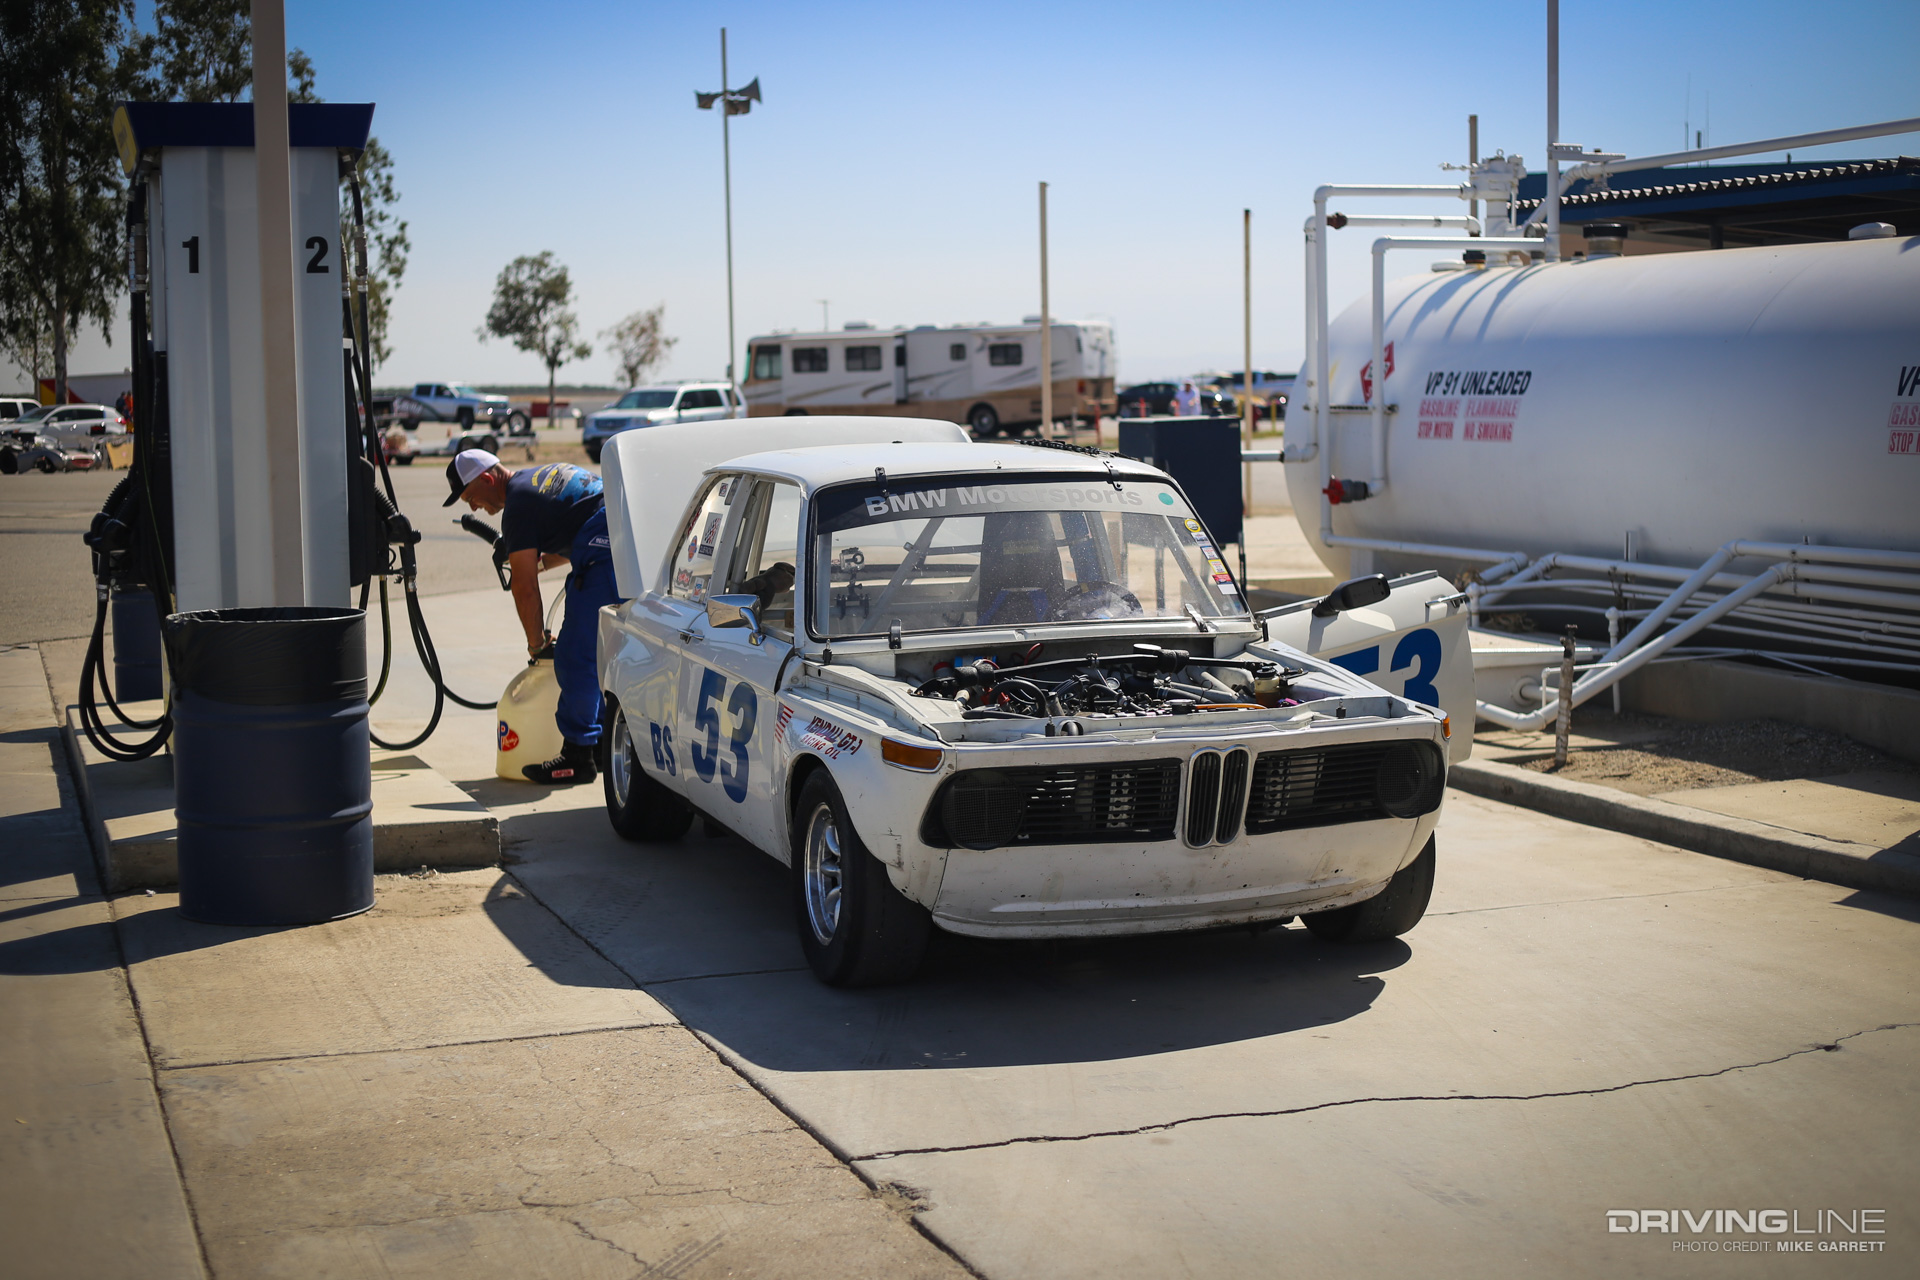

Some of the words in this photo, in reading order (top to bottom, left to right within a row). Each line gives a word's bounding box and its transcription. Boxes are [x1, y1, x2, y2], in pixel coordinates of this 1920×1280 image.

[182, 236, 199, 274] 1
[305, 236, 329, 274] 2
[1425, 371, 1444, 395] VP
[1443, 371, 1461, 395] 91
[1461, 371, 1532, 396] UNLEADED
[1419, 399, 1460, 418] GASOLINE
[1466, 399, 1519, 418] FLAMMABLE
[1418, 421, 1433, 438] STOP
[1434, 421, 1454, 439] MOTOR
[1464, 421, 1475, 440] NO
[1477, 421, 1513, 441] SMOKING
[1890, 431, 1913, 453] STOP
[864, 488, 947, 517] BMW
[959, 485, 1143, 507] Motorsports
[692, 667, 758, 804] 53
[804, 715, 843, 743] KENDALL
[650, 722, 676, 777] BS
[800, 734, 827, 751] RACING
[824, 746, 841, 760] OIL
